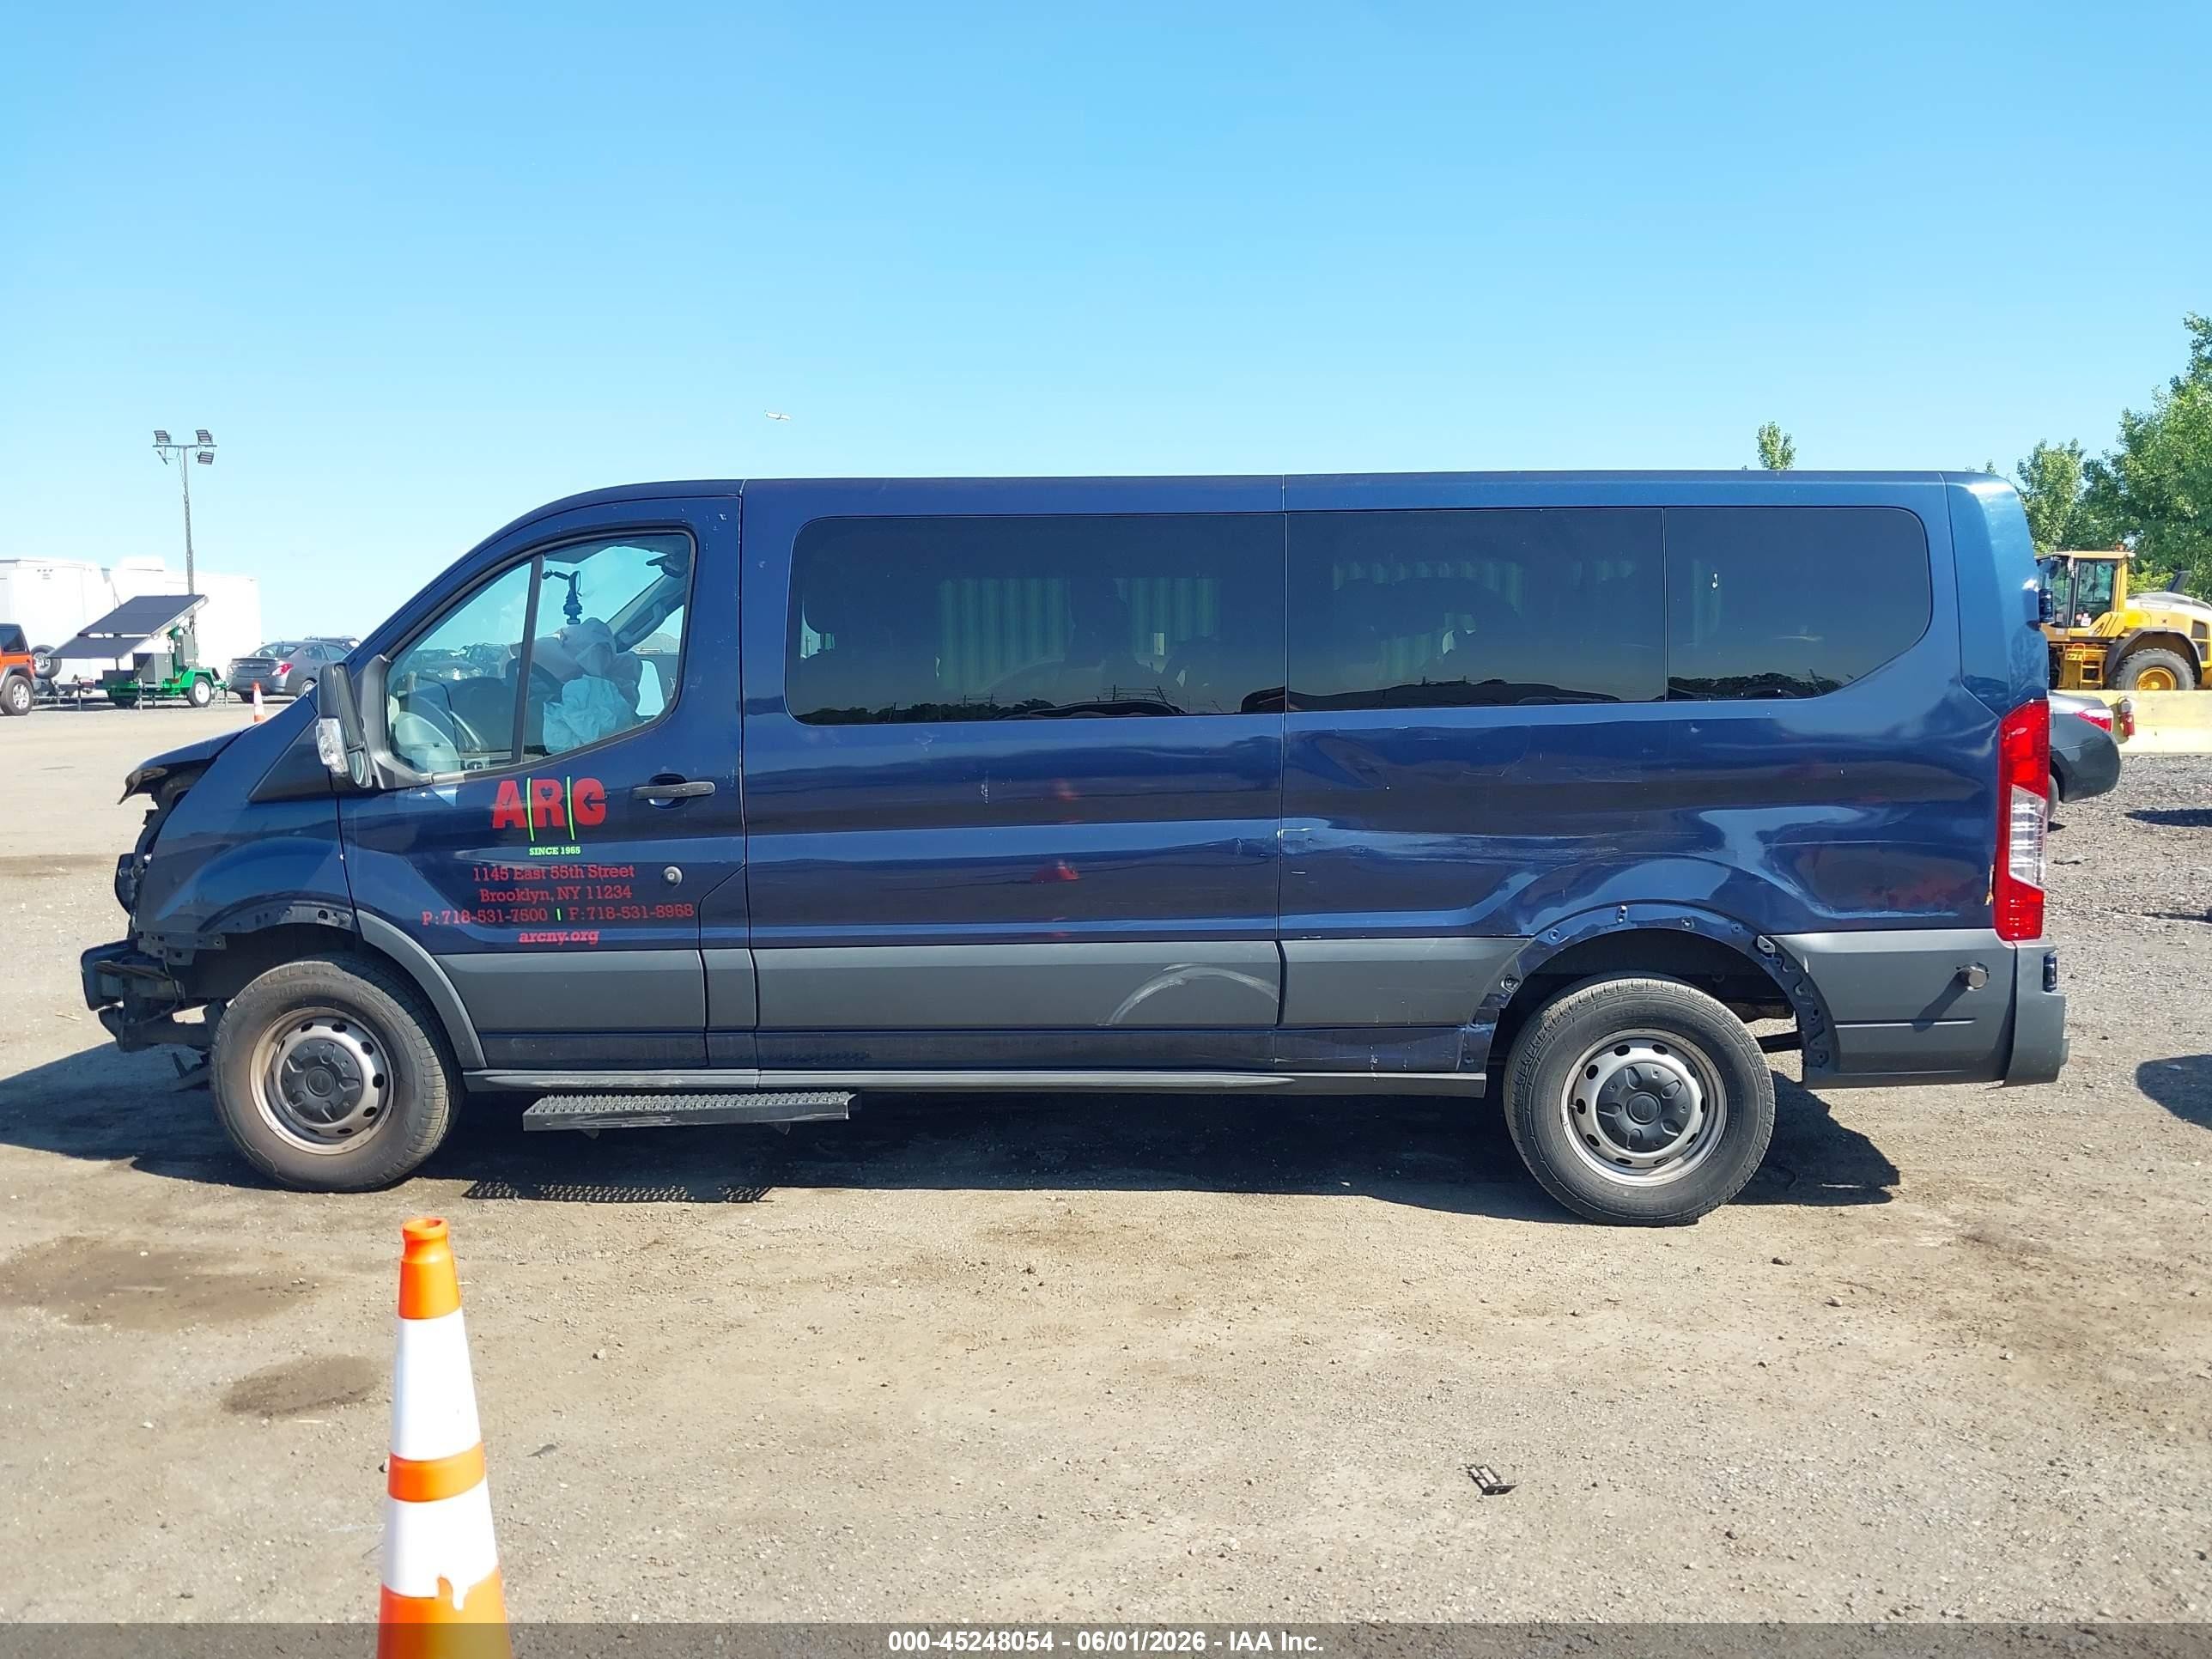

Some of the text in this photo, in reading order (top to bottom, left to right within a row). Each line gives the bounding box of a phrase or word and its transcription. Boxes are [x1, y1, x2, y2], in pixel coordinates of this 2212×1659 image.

[492, 777, 606, 830] ARC
[561, 847, 581, 855] 1955
[473, 864, 635, 881] 1145 East 55th Street
[479, 884, 633, 904] Brooklyn, NY 11234
[519, 930, 599, 945] arcny.org
